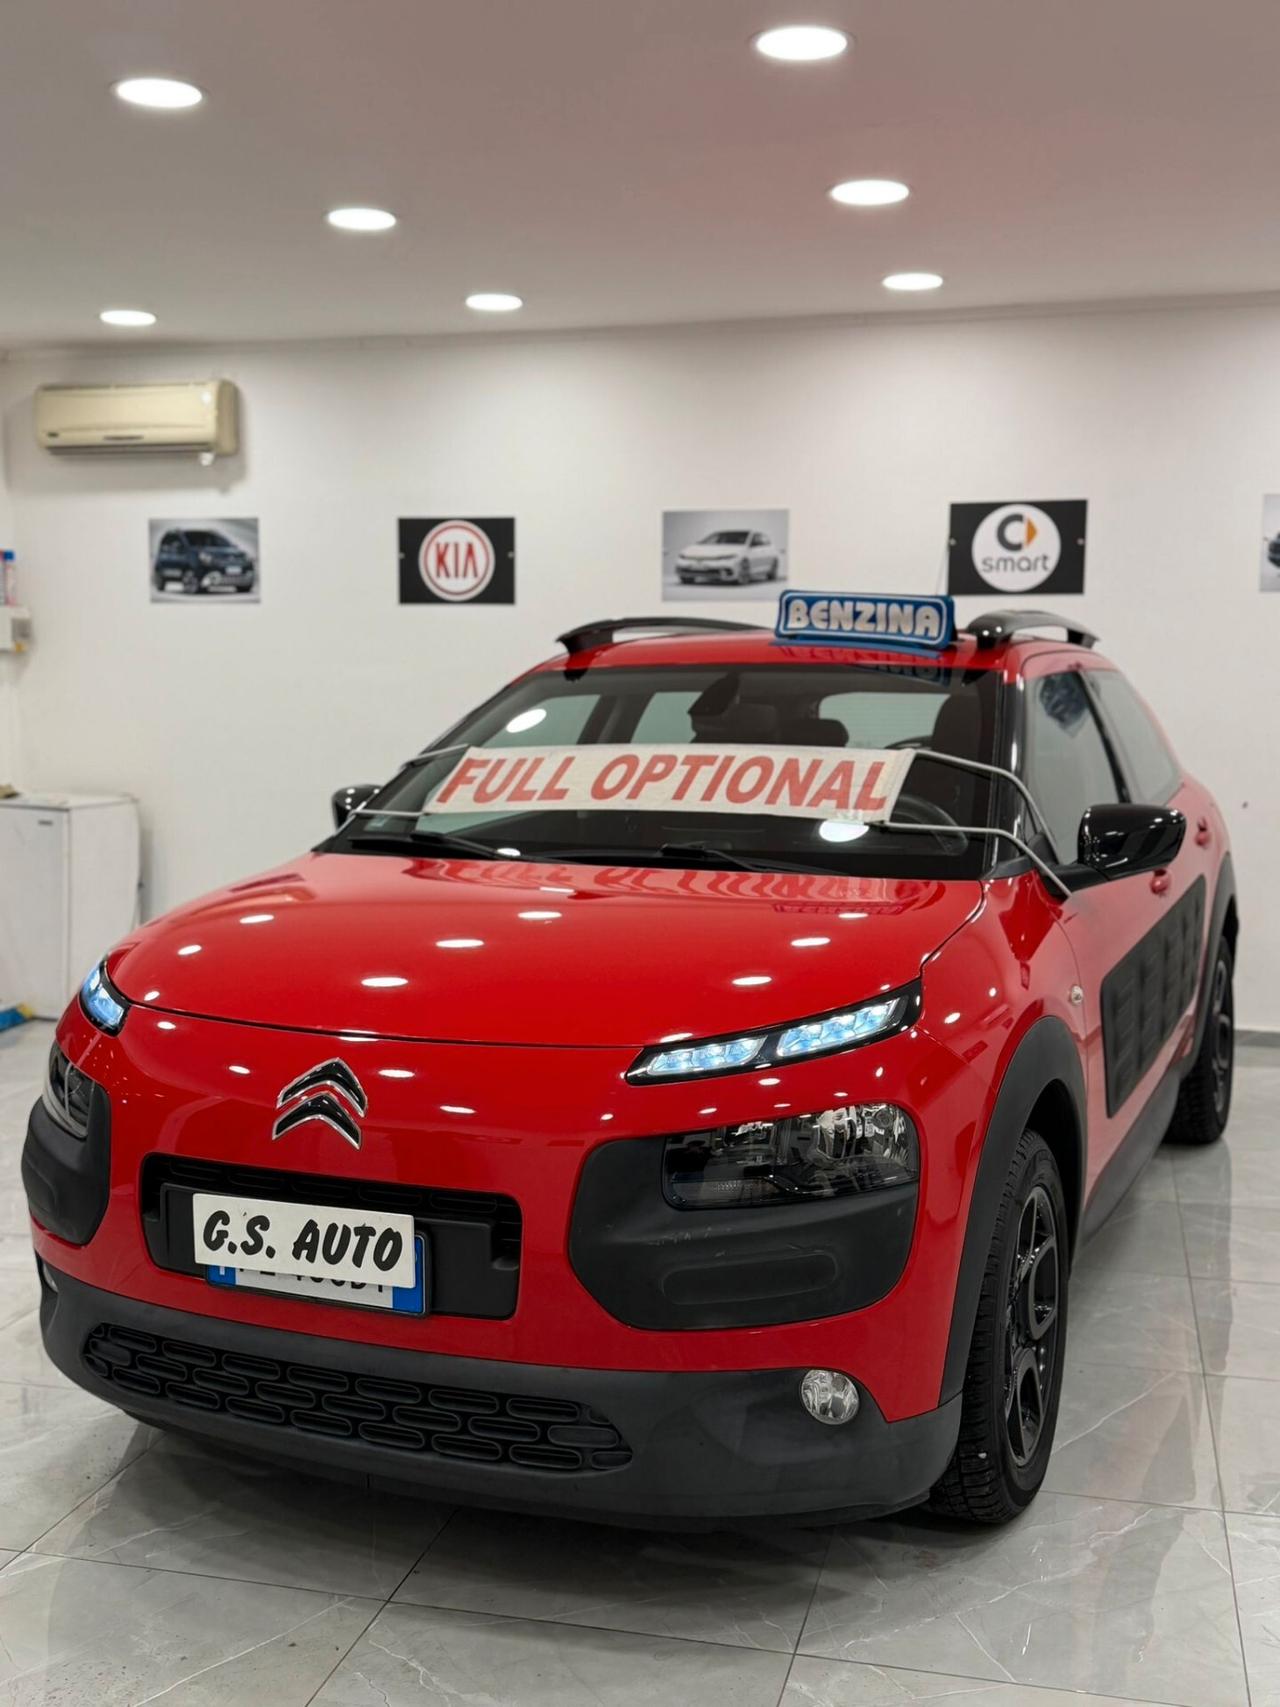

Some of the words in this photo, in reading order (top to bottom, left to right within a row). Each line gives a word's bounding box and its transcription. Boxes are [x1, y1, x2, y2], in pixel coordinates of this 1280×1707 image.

[435, 541, 478, 579] KIA
[981, 553, 1049, 573] smart
[787, 599, 941, 638] BENZINA
[436, 755, 576, 804] FULL
[590, 753, 888, 812] OPTIONAL
[203, 1210, 276, 1259] G.S.
[292, 1218, 403, 1272] AUTO
